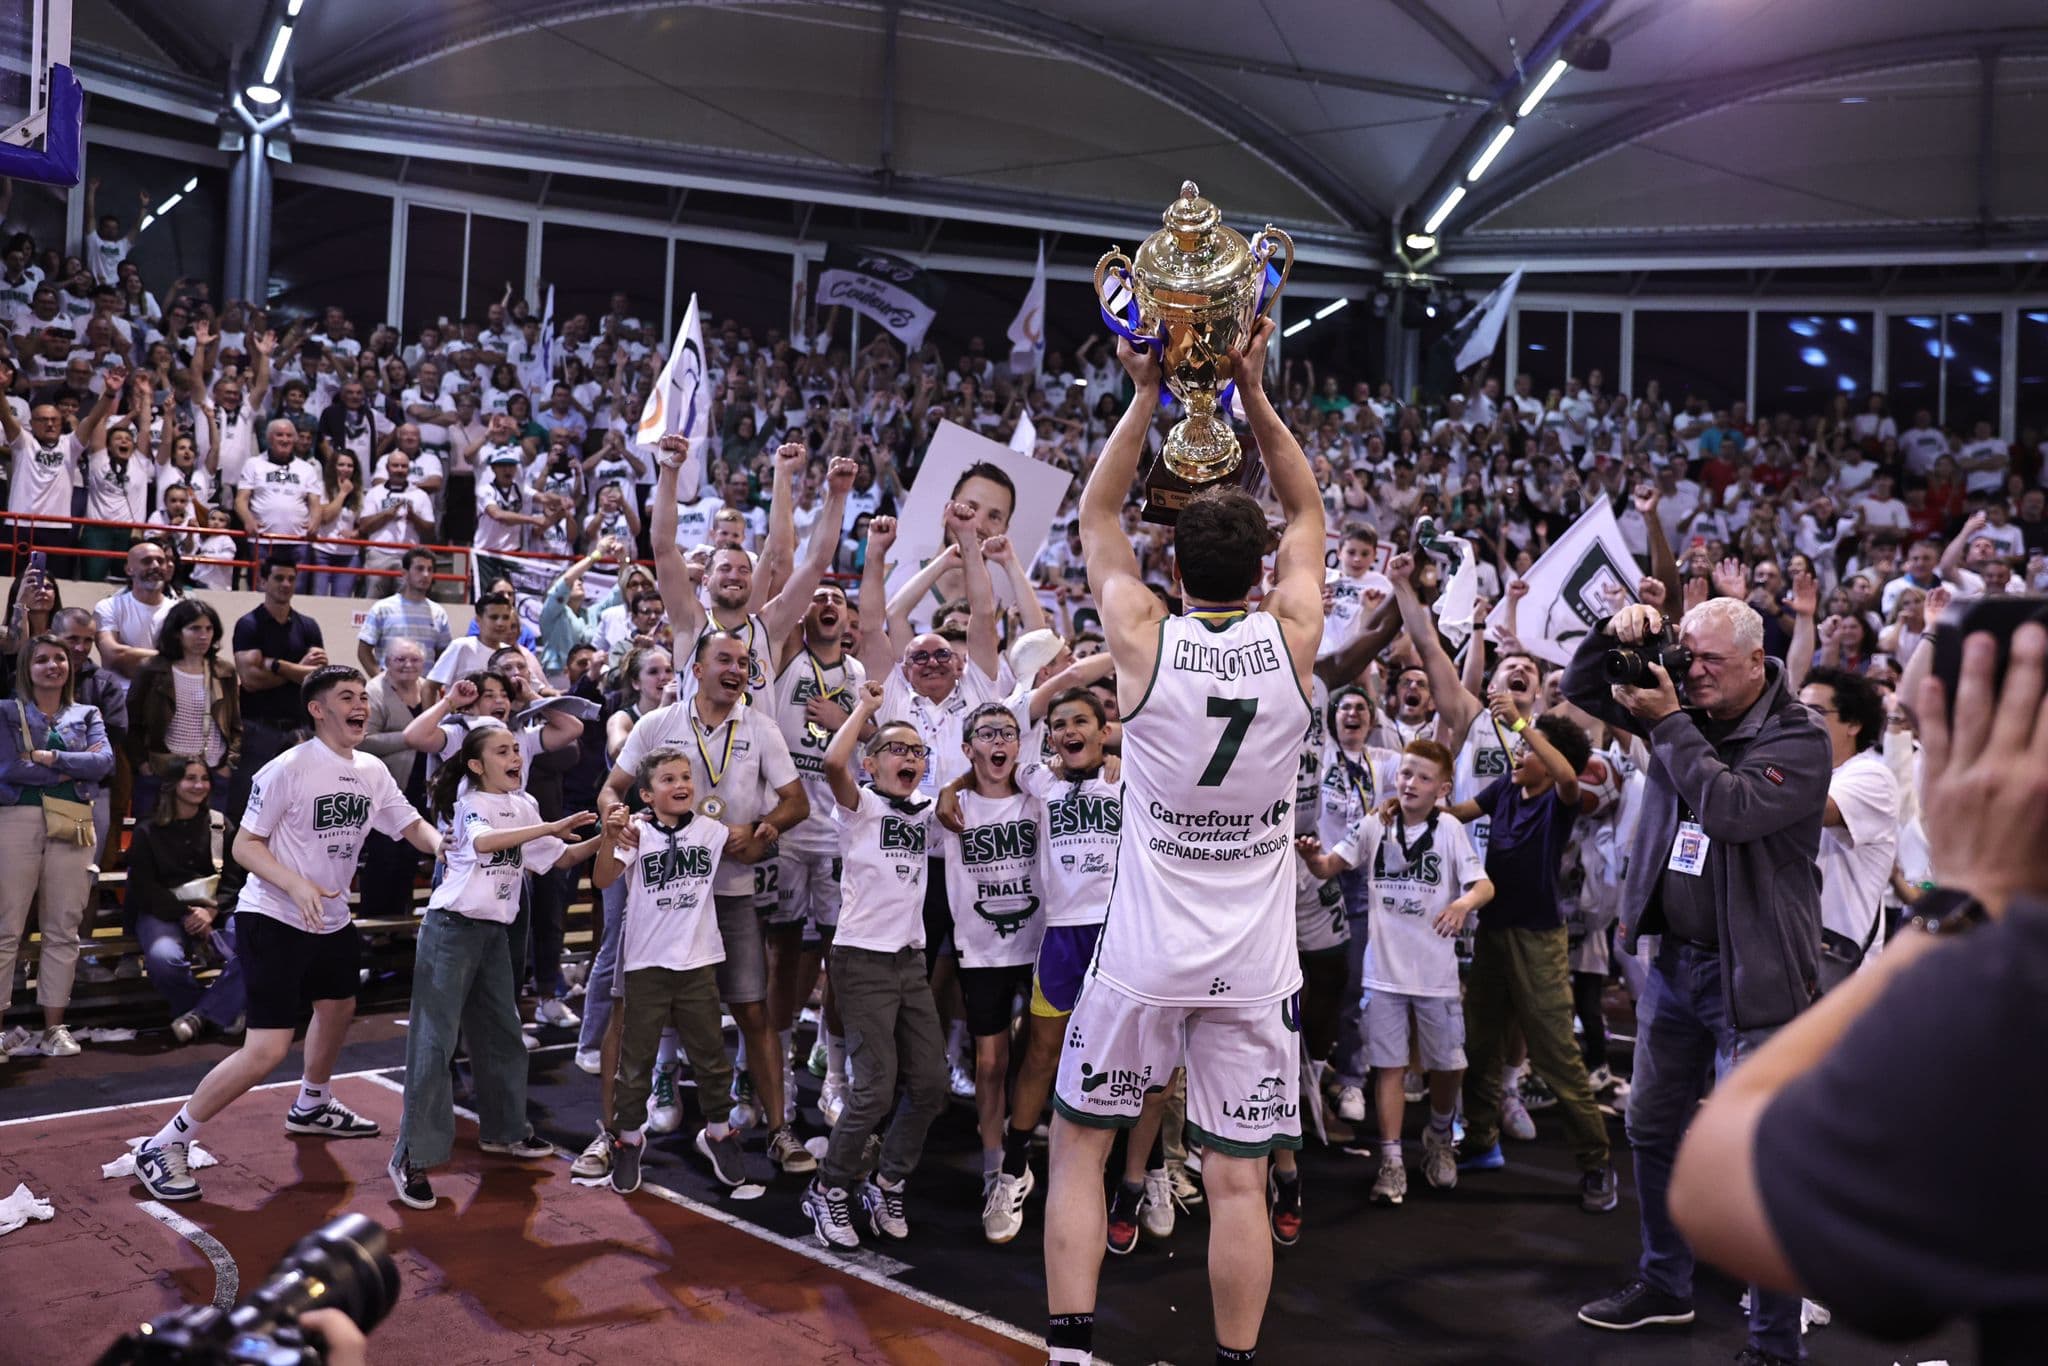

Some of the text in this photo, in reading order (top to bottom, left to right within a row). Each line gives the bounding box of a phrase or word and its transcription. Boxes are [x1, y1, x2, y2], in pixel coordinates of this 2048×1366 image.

[1197, 696, 1259, 786] 7
[1047, 796, 1121, 840] ESMS
[1150, 801, 1254, 827] Carrefour
[960, 820, 1039, 865] ESMS
[1177, 828, 1251, 842] contact
[977, 879, 1033, 899] FINALE
[1088, 1097, 1118, 1106] PIERRE
